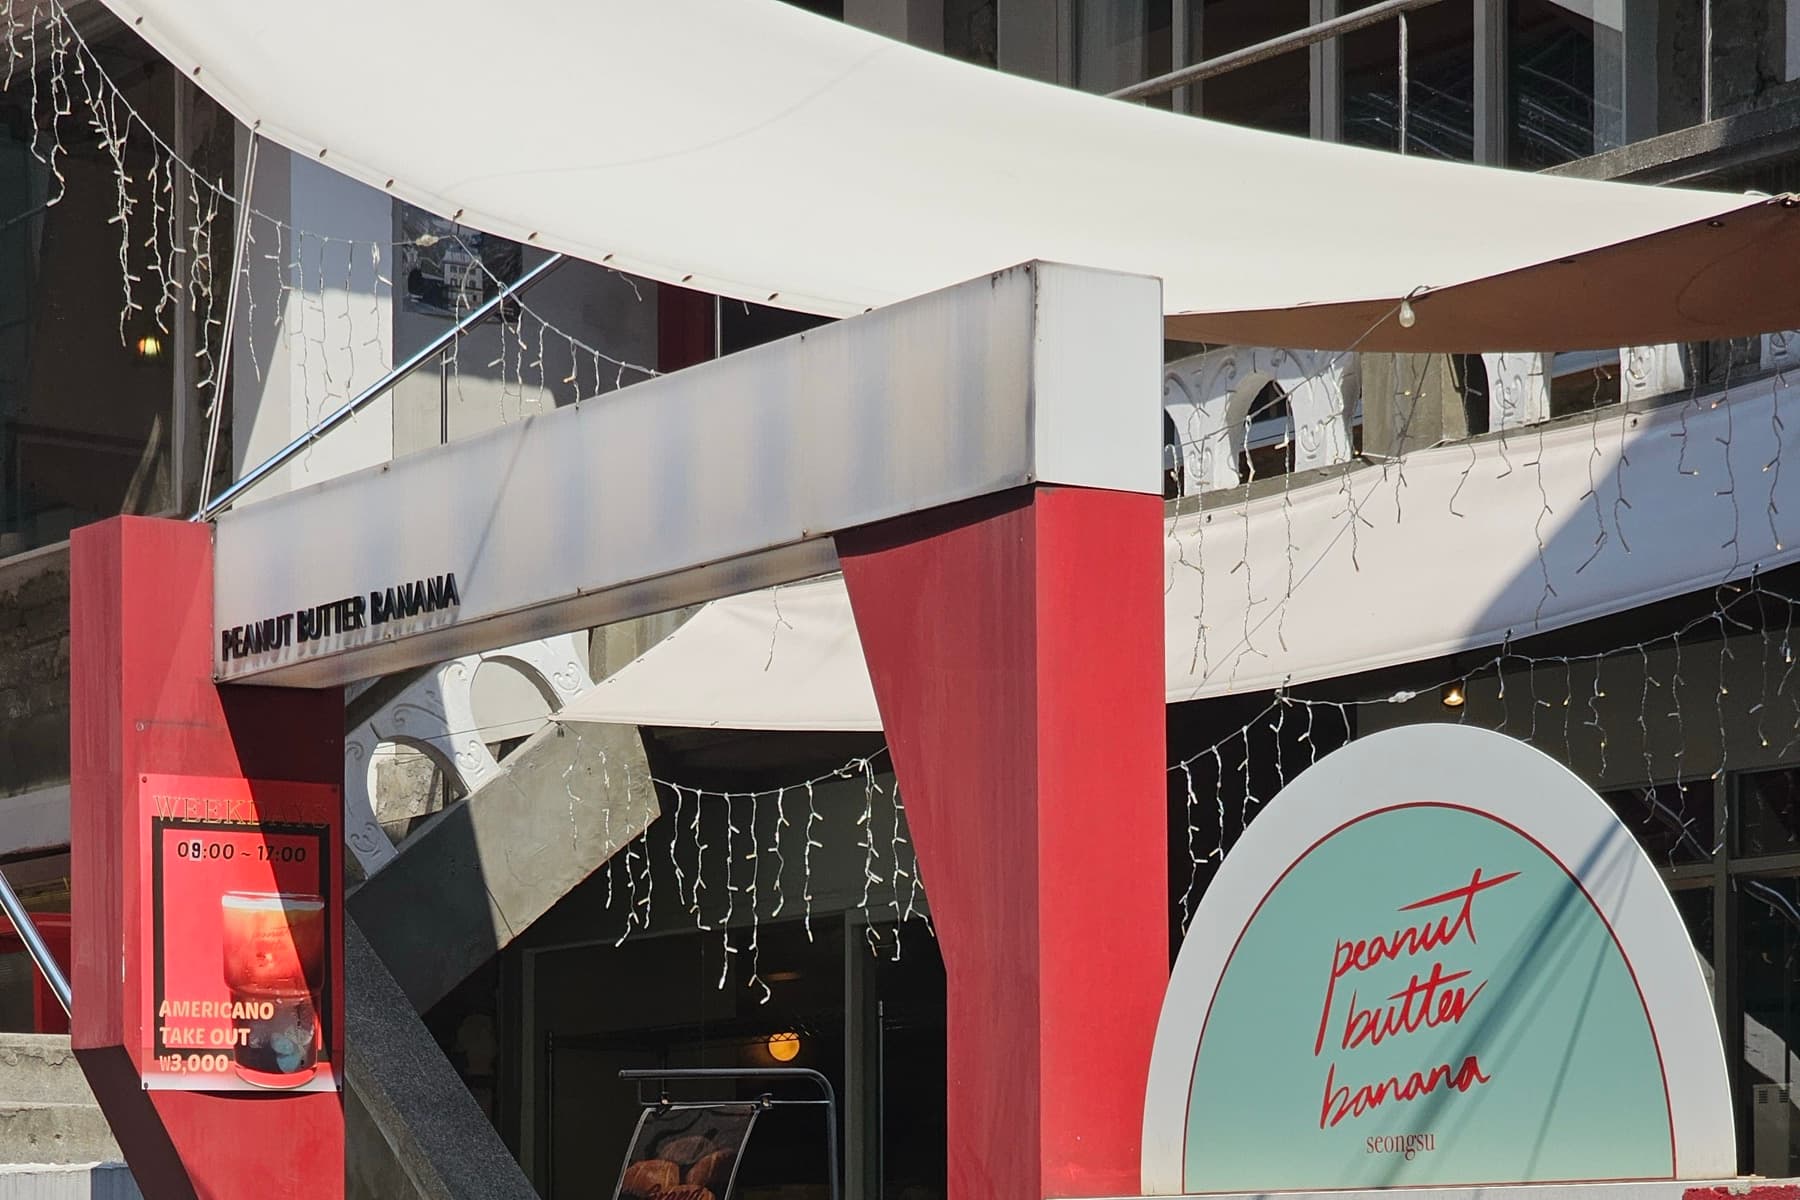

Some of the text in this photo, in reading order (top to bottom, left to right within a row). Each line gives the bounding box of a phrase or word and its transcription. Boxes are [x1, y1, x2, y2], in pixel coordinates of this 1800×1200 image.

[222, 573, 460, 661] PEANUT BUTTER BANANA
[153, 795, 329, 829] WEEKDAYS
[177, 841, 235, 861] 09:00
[257, 845, 306, 862] 17:00
[1313, 868, 1522, 1056] peanut
[159, 1000, 275, 1020] AMERICANO
[1341, 962, 1489, 1050] butter
[159, 1027, 251, 1046] TAKE OUT
[1319, 1056, 1492, 1129] banana
[1366, 1133, 1436, 1161] seongsu
